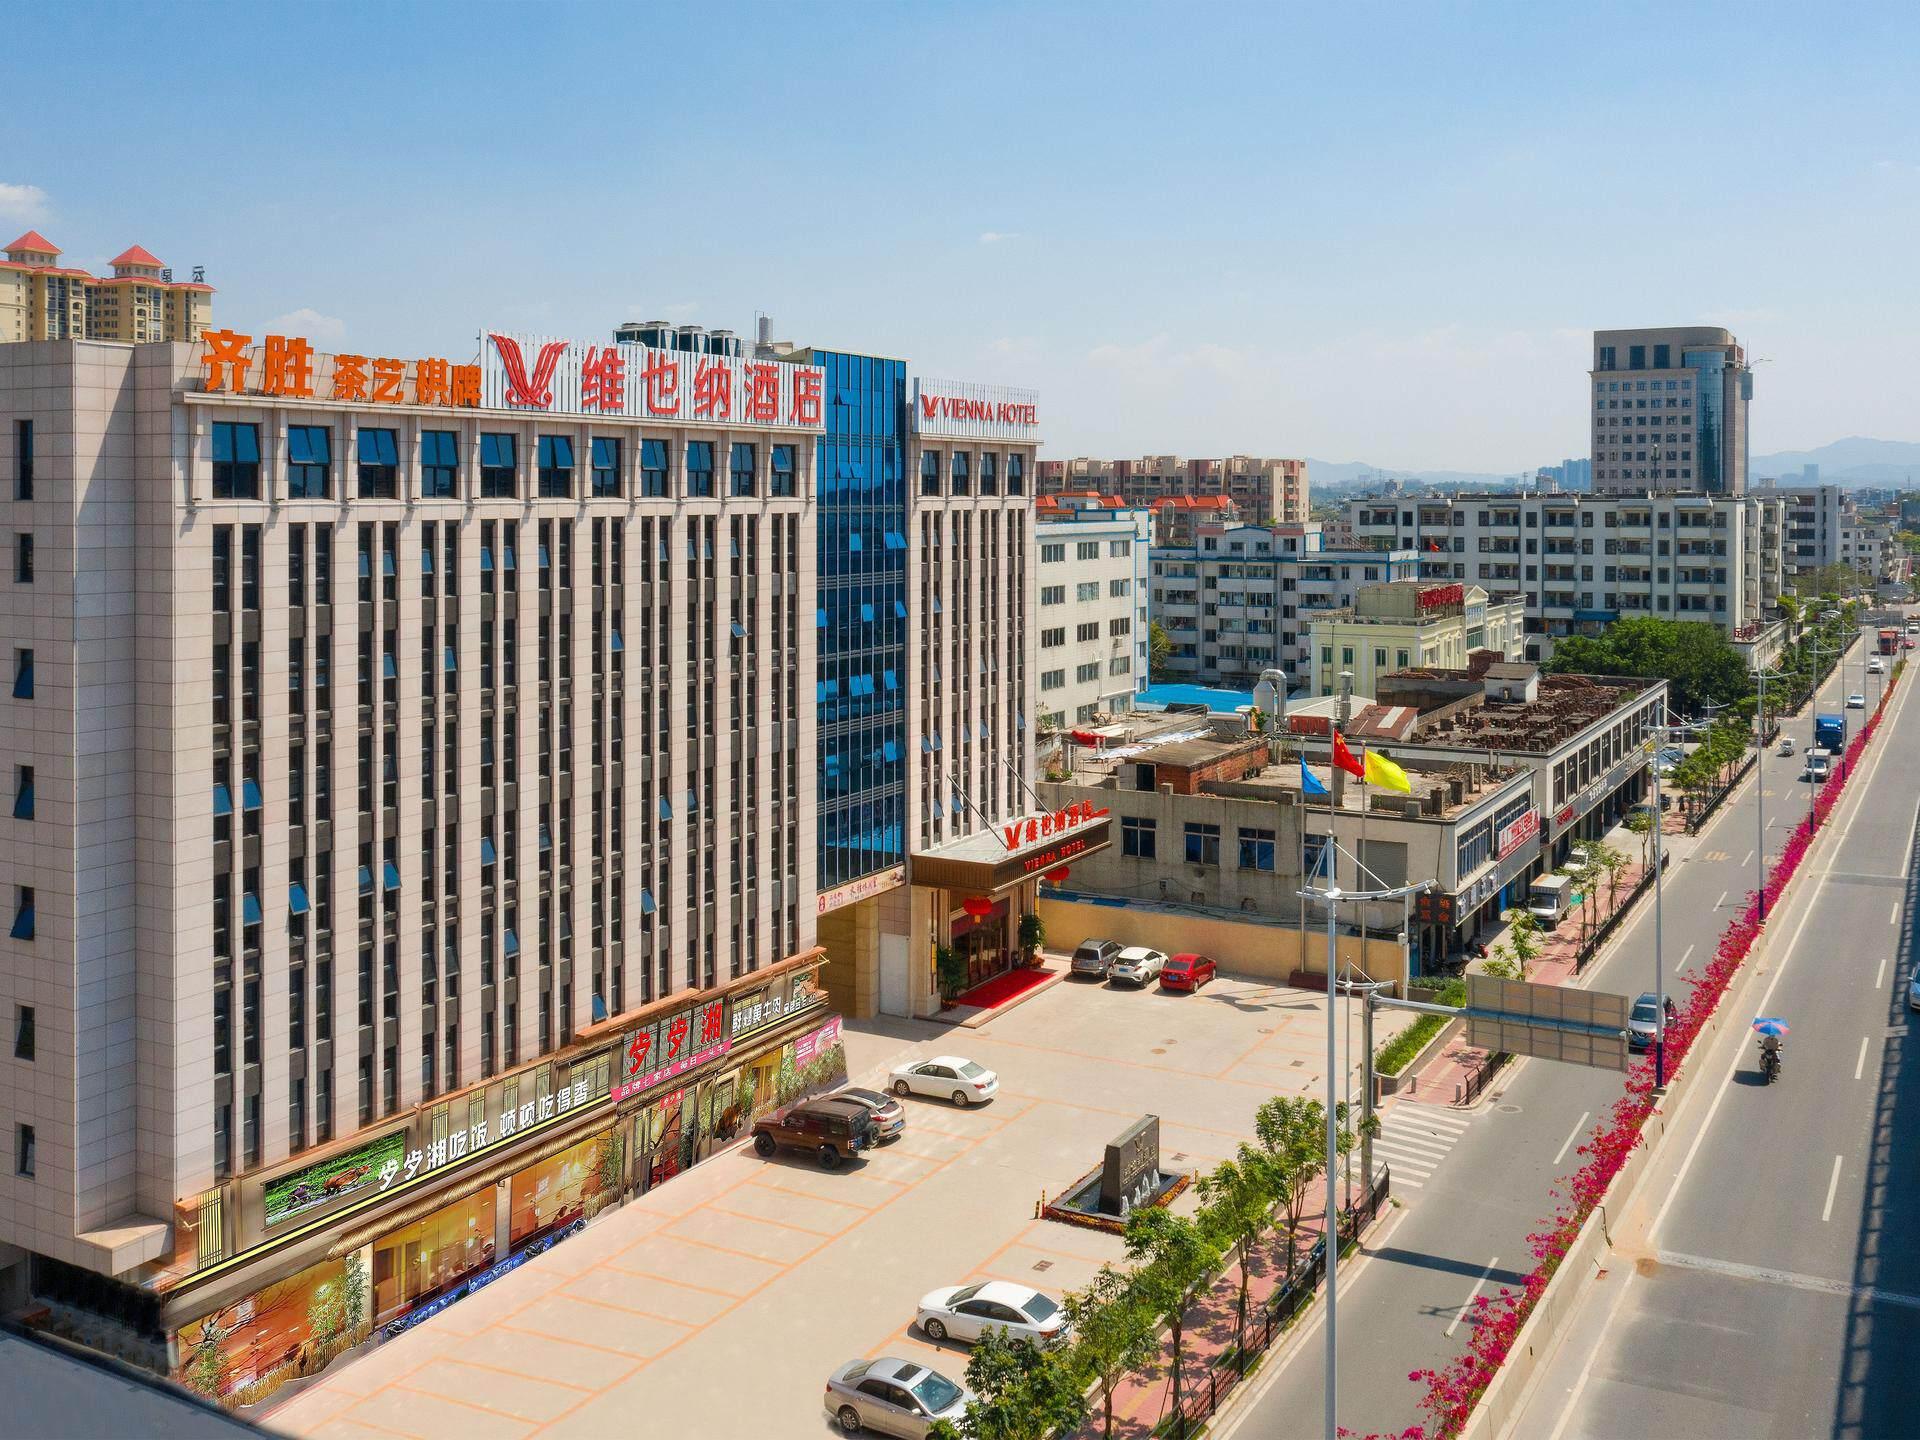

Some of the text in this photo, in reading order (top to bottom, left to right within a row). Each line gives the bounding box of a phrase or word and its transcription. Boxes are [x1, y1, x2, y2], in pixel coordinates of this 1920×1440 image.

[201, 328, 482, 408] 齐胜 茶艺棋牌
[581, 345, 823, 424] 维也纳酒店
[941, 397, 993, 421] VIENNA
[997, 402, 1040, 424] HOTEL
[1025, 839, 1086, 872] VIENNA HOTEL
